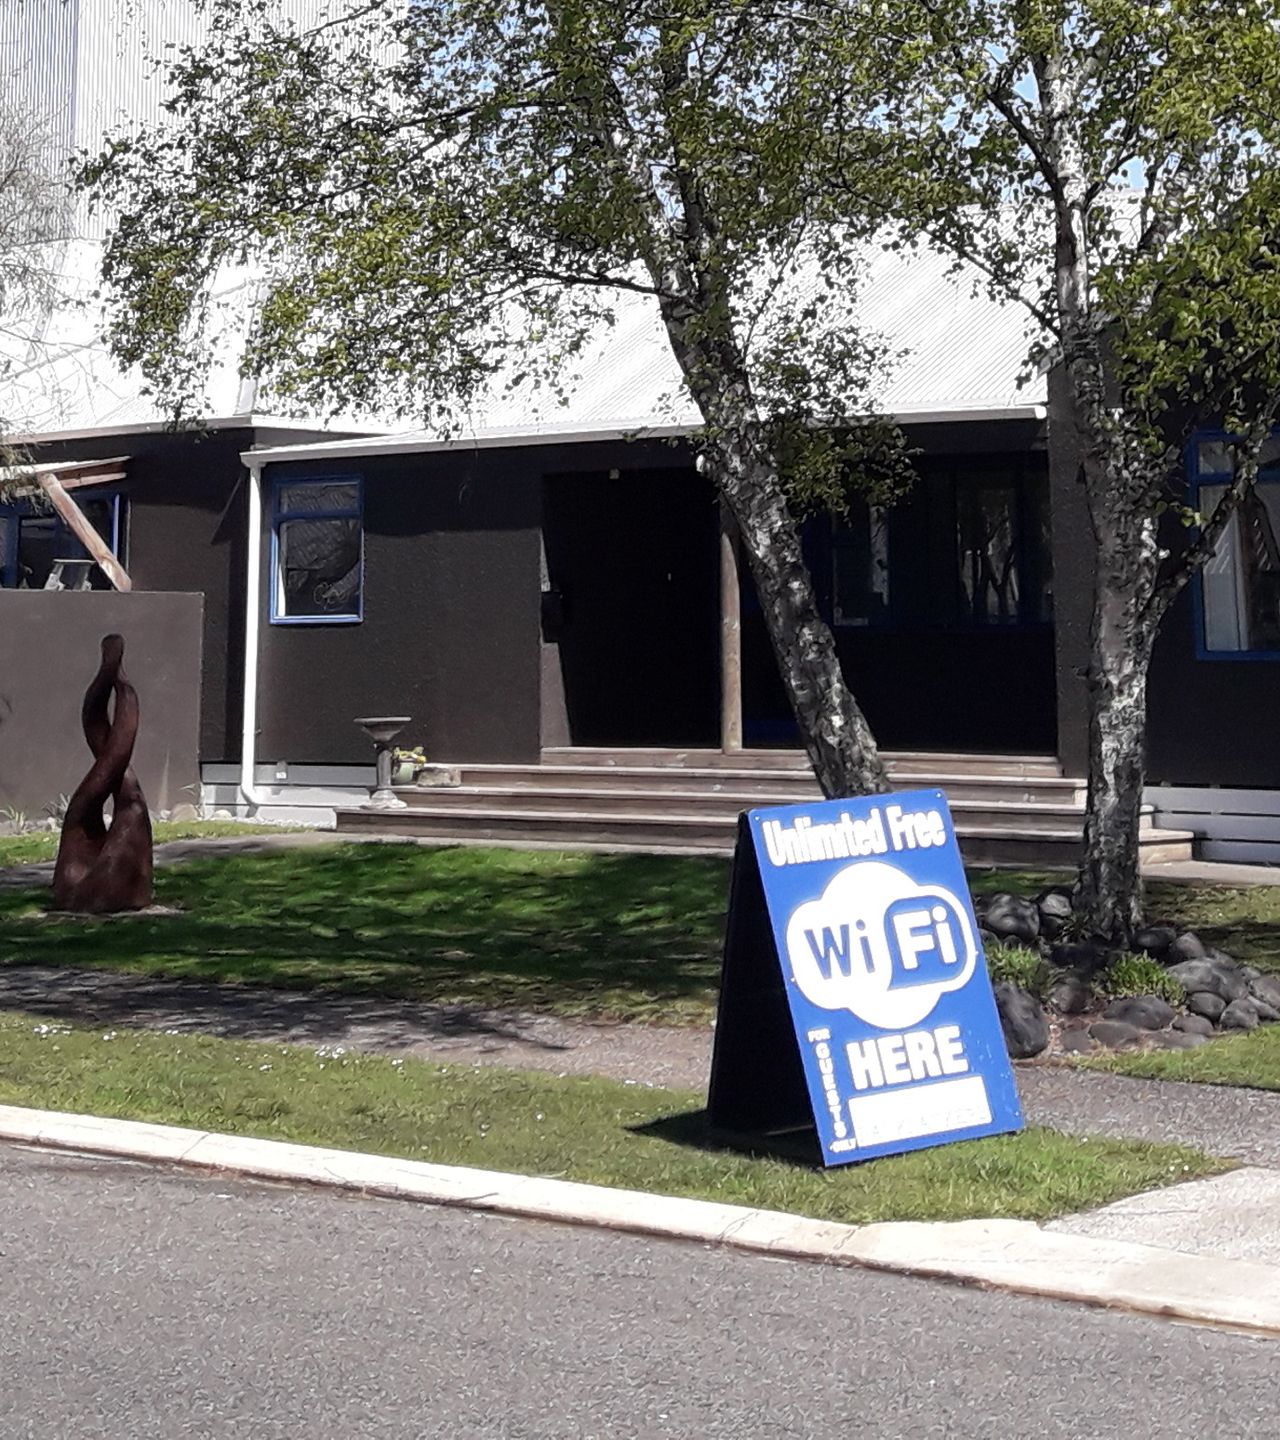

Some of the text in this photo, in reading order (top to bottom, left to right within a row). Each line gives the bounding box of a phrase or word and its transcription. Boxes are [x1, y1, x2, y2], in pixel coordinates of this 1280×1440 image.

[762, 805, 946, 866] Unlimited Free
[846, 1025, 969, 1090] HERE
